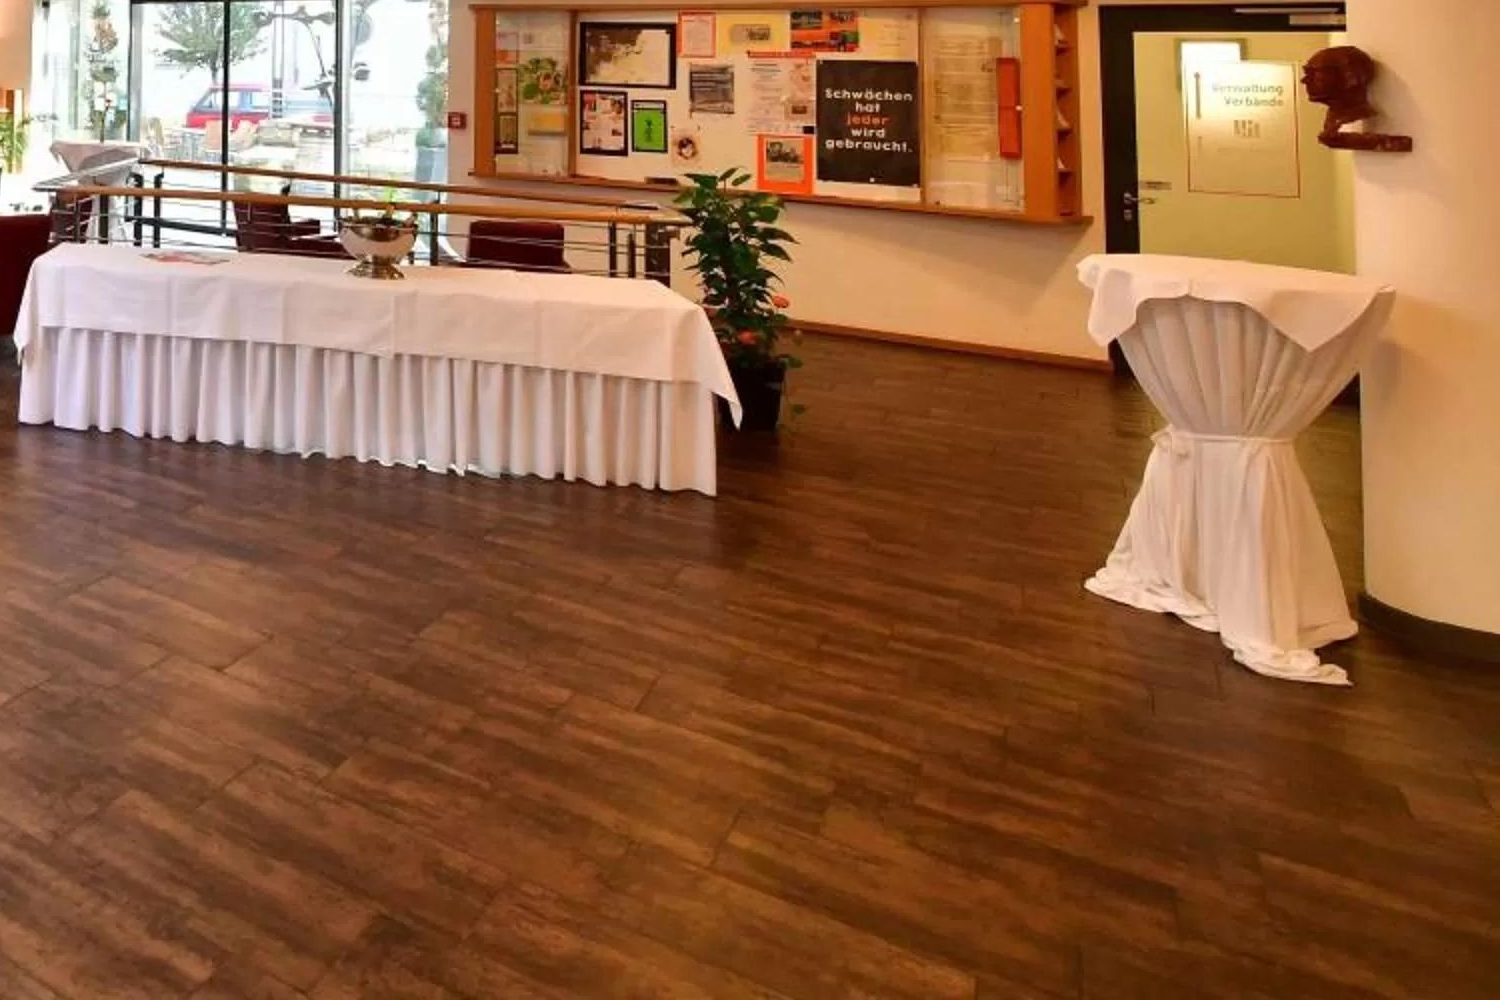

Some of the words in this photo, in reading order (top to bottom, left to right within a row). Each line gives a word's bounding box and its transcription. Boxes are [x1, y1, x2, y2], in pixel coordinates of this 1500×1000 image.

[824, 87, 913, 101] Schwächen
[855, 101, 881, 113] hat
[847, 112, 890, 126] jeder
[850, 127, 886, 138] wird
[825, 138, 913, 153] gebraucht.
